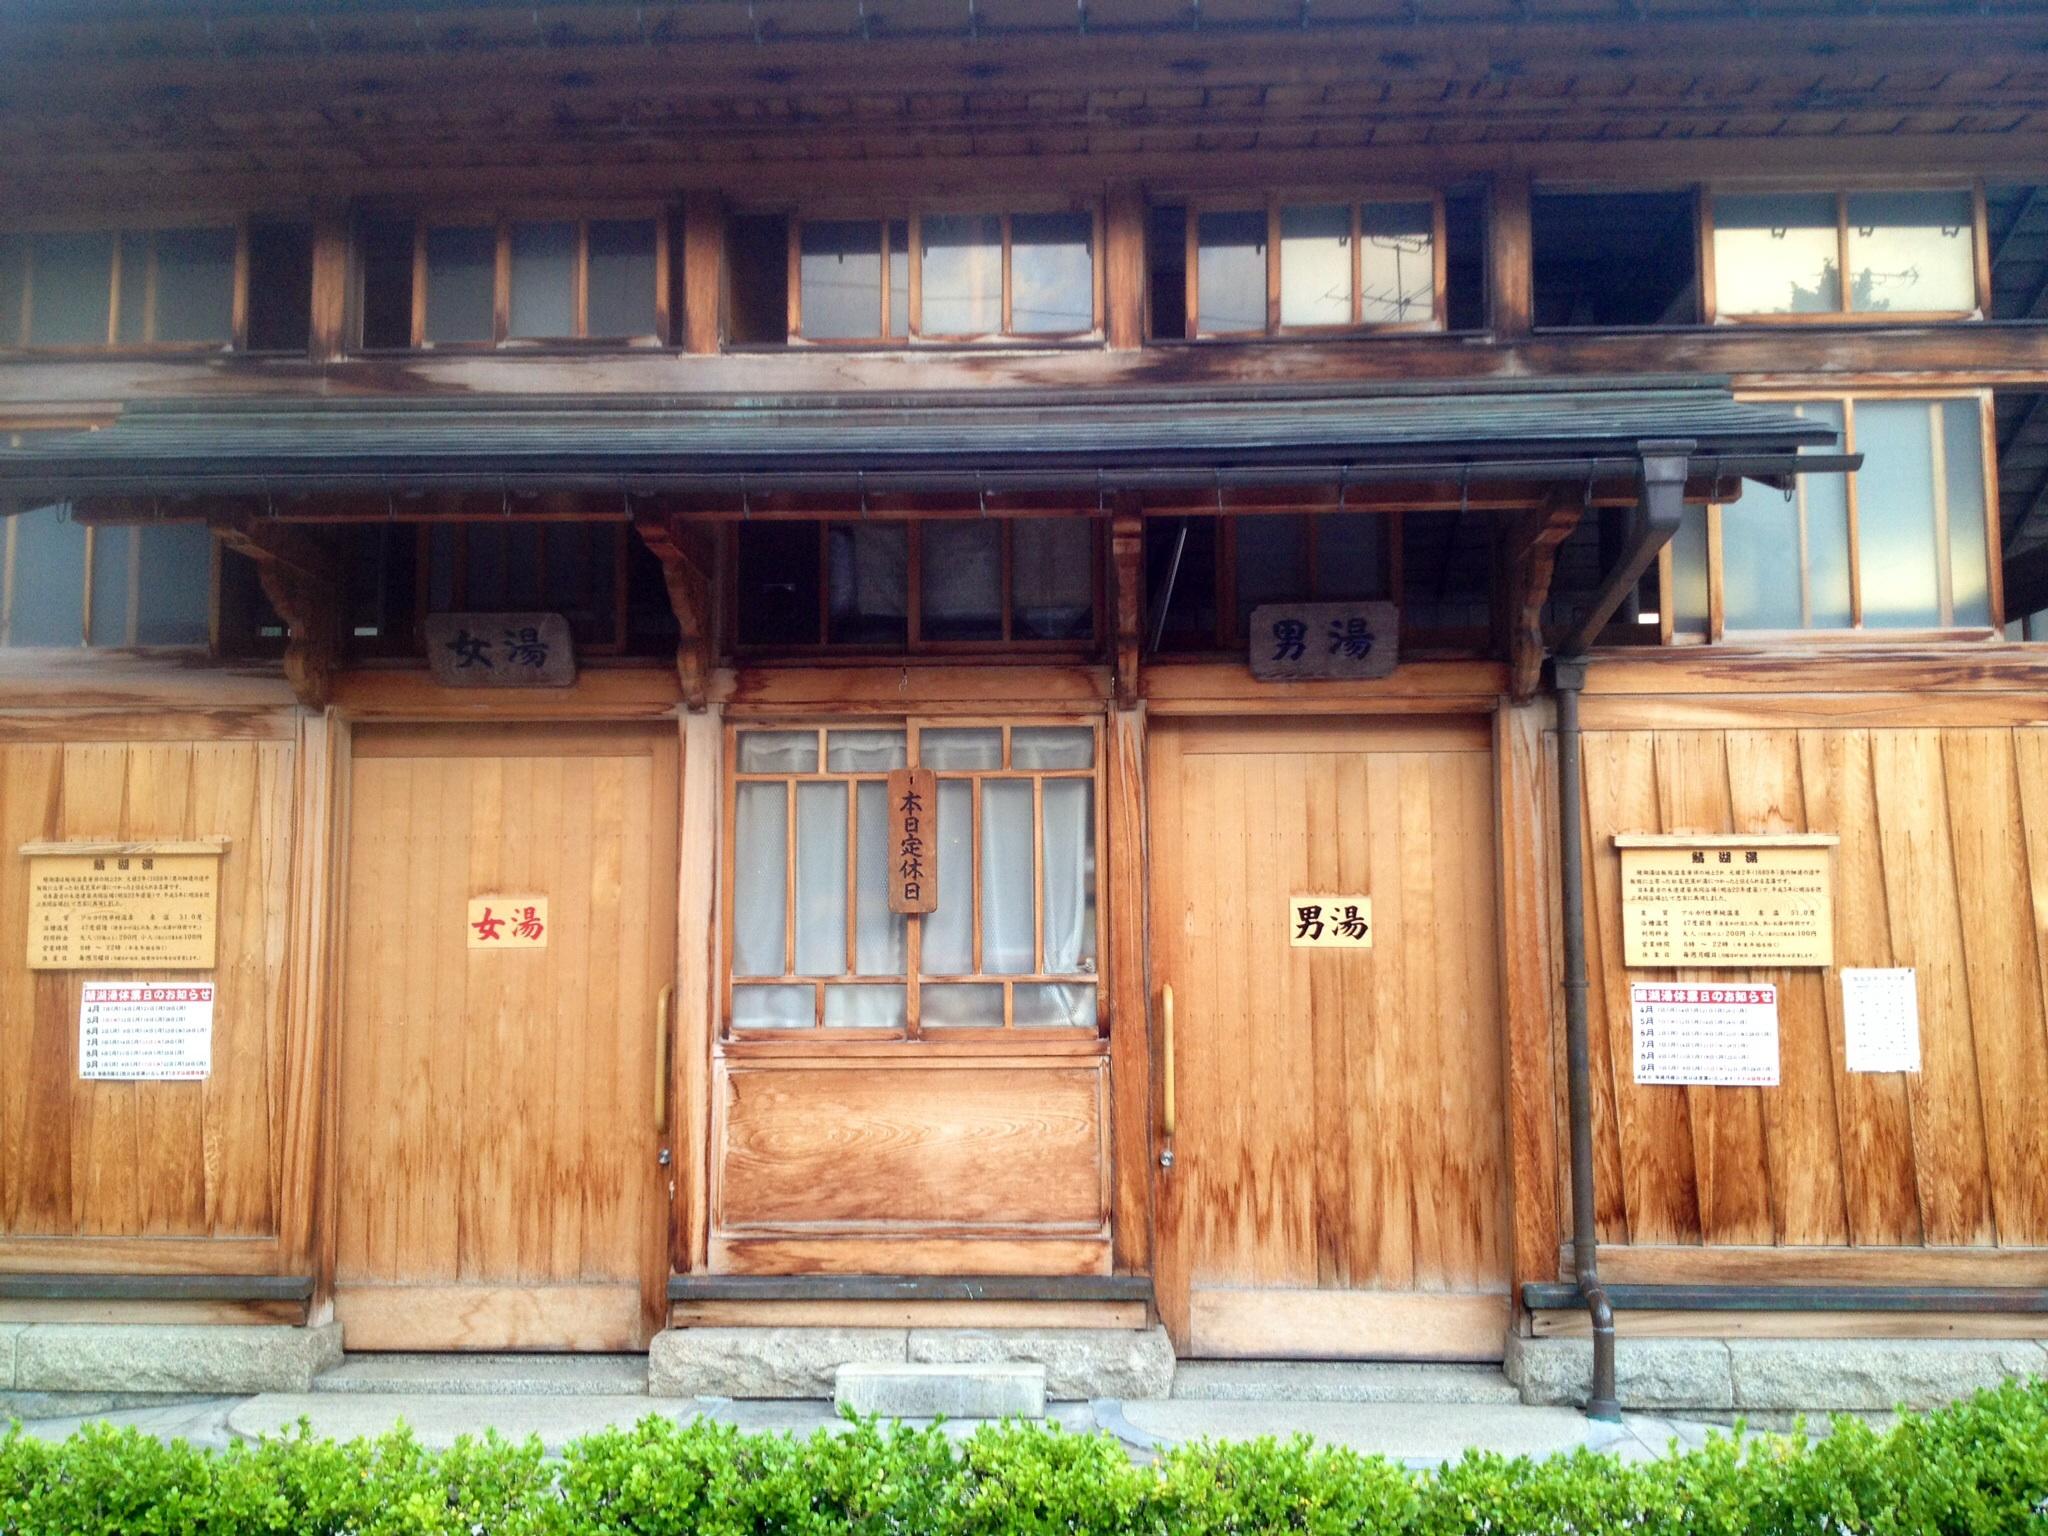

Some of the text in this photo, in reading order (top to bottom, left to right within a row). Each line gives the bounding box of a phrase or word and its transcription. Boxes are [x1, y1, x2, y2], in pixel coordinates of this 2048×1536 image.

[446, 627, 550, 669] 女湯
[1272, 617, 1376, 661] 男湯
[898, 790, 924, 901] 本日定休日
[471, 906, 545, 941] 女湯
[1294, 904, 1369, 941] 男湯
